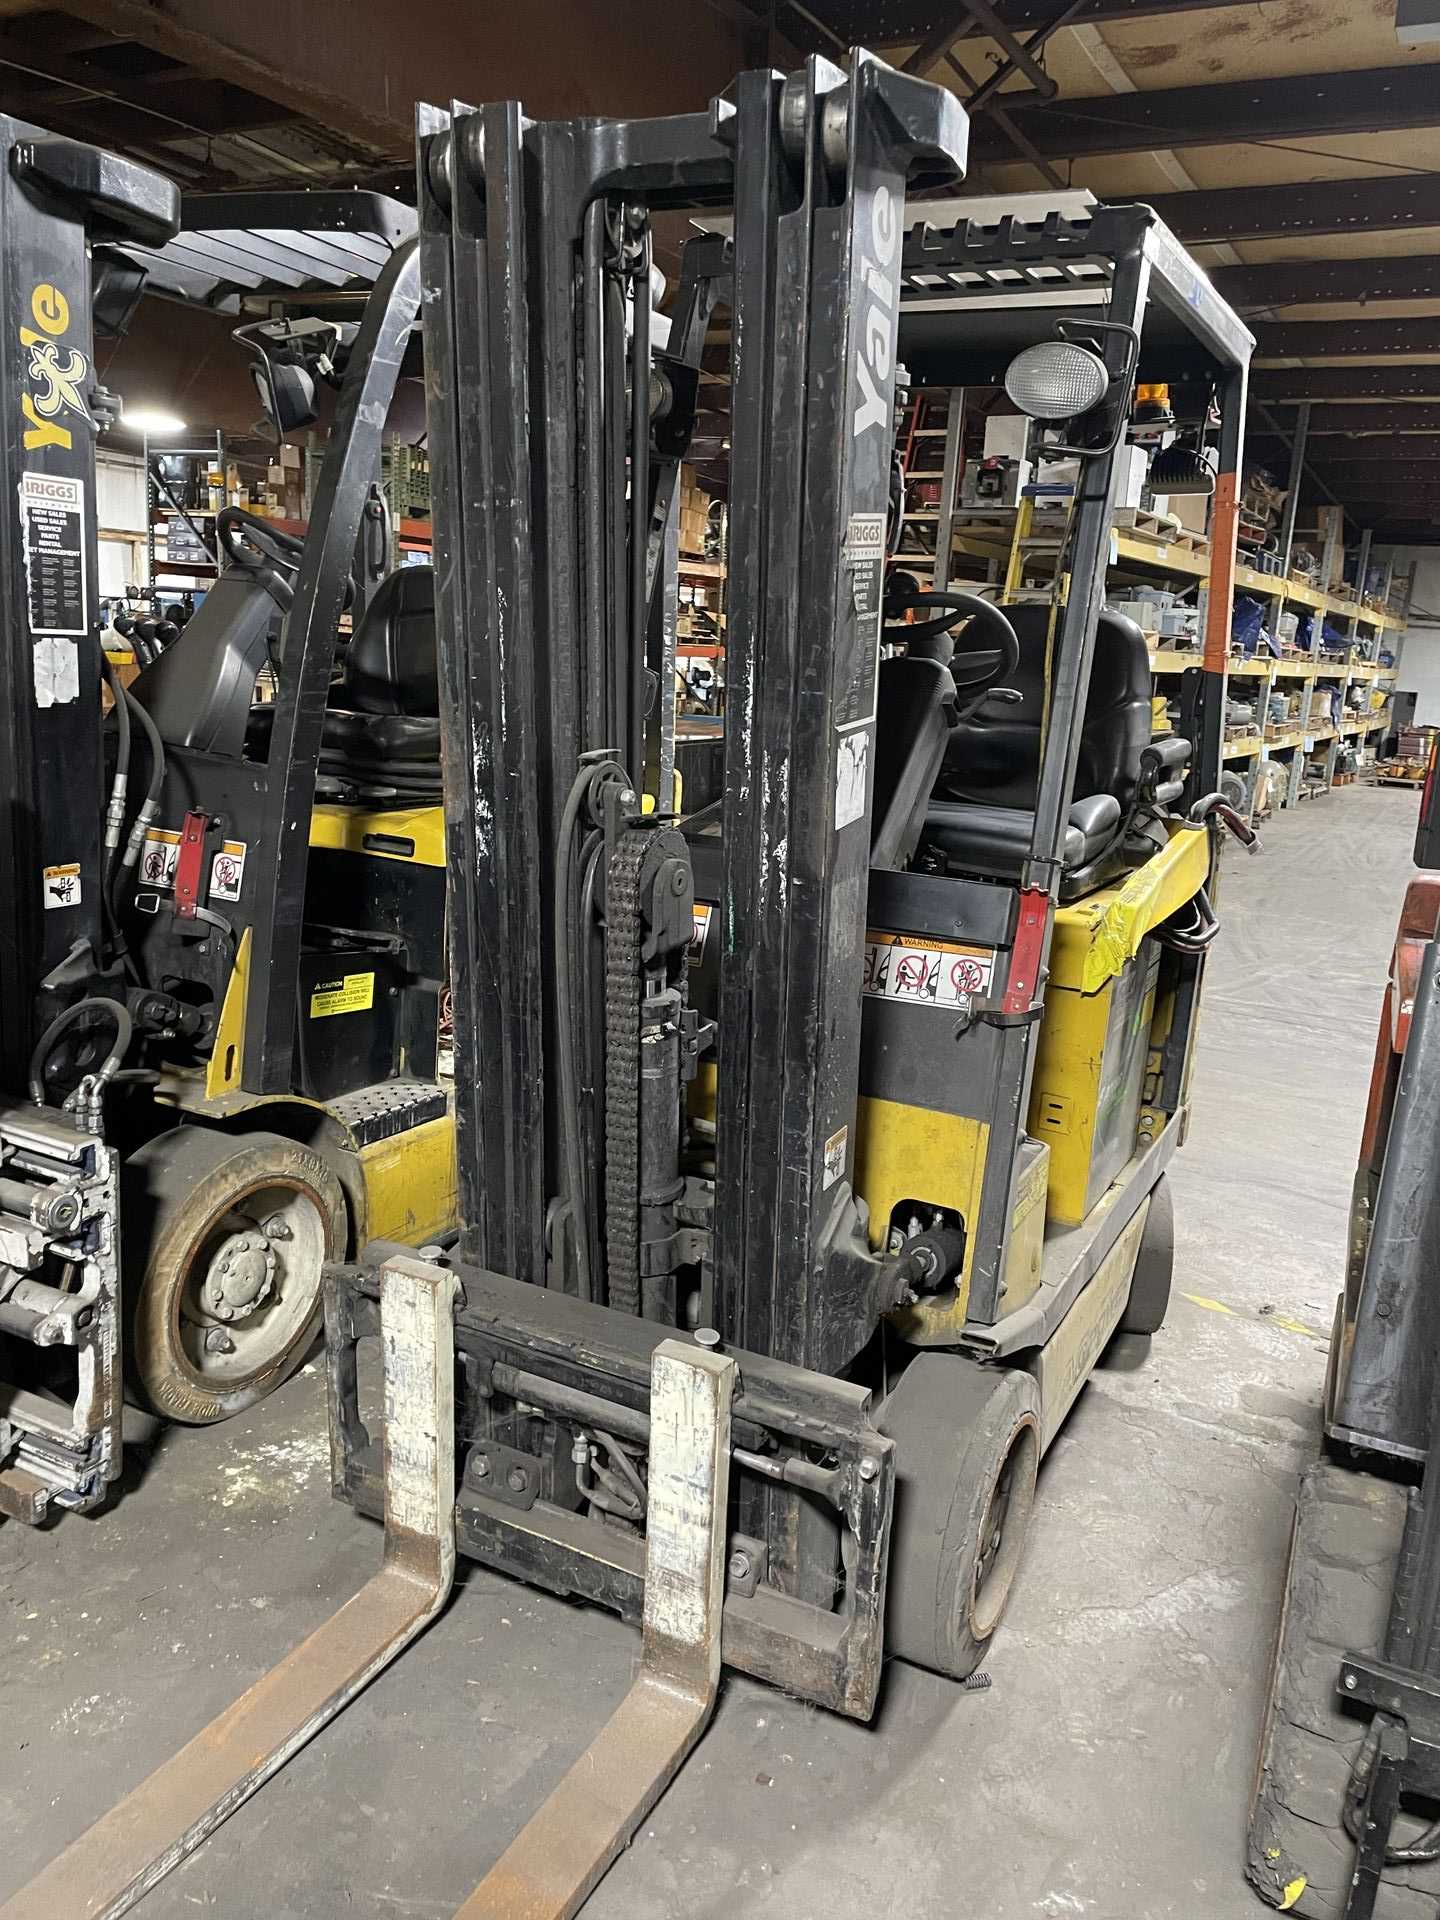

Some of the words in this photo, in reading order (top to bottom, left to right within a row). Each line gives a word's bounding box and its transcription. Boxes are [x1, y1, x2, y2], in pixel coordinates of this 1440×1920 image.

[853, 186, 896, 437] Yale
[19, 284, 72, 450] Yle
[31, 508, 48, 516] NEW
[47, 510, 67, 519] SALES
[31, 516, 49, 524] USED
[49, 518, 68, 526] SALES
[37, 524, 62, 533] SERVICE
[40, 532, 60, 540] PARTS
[38, 539, 62, 548] RENTAL
[38, 547, 81, 557] MANAGEMENT
[904, 938, 944, 950] WARNING
[322, 981, 343, 989] CAUTION
